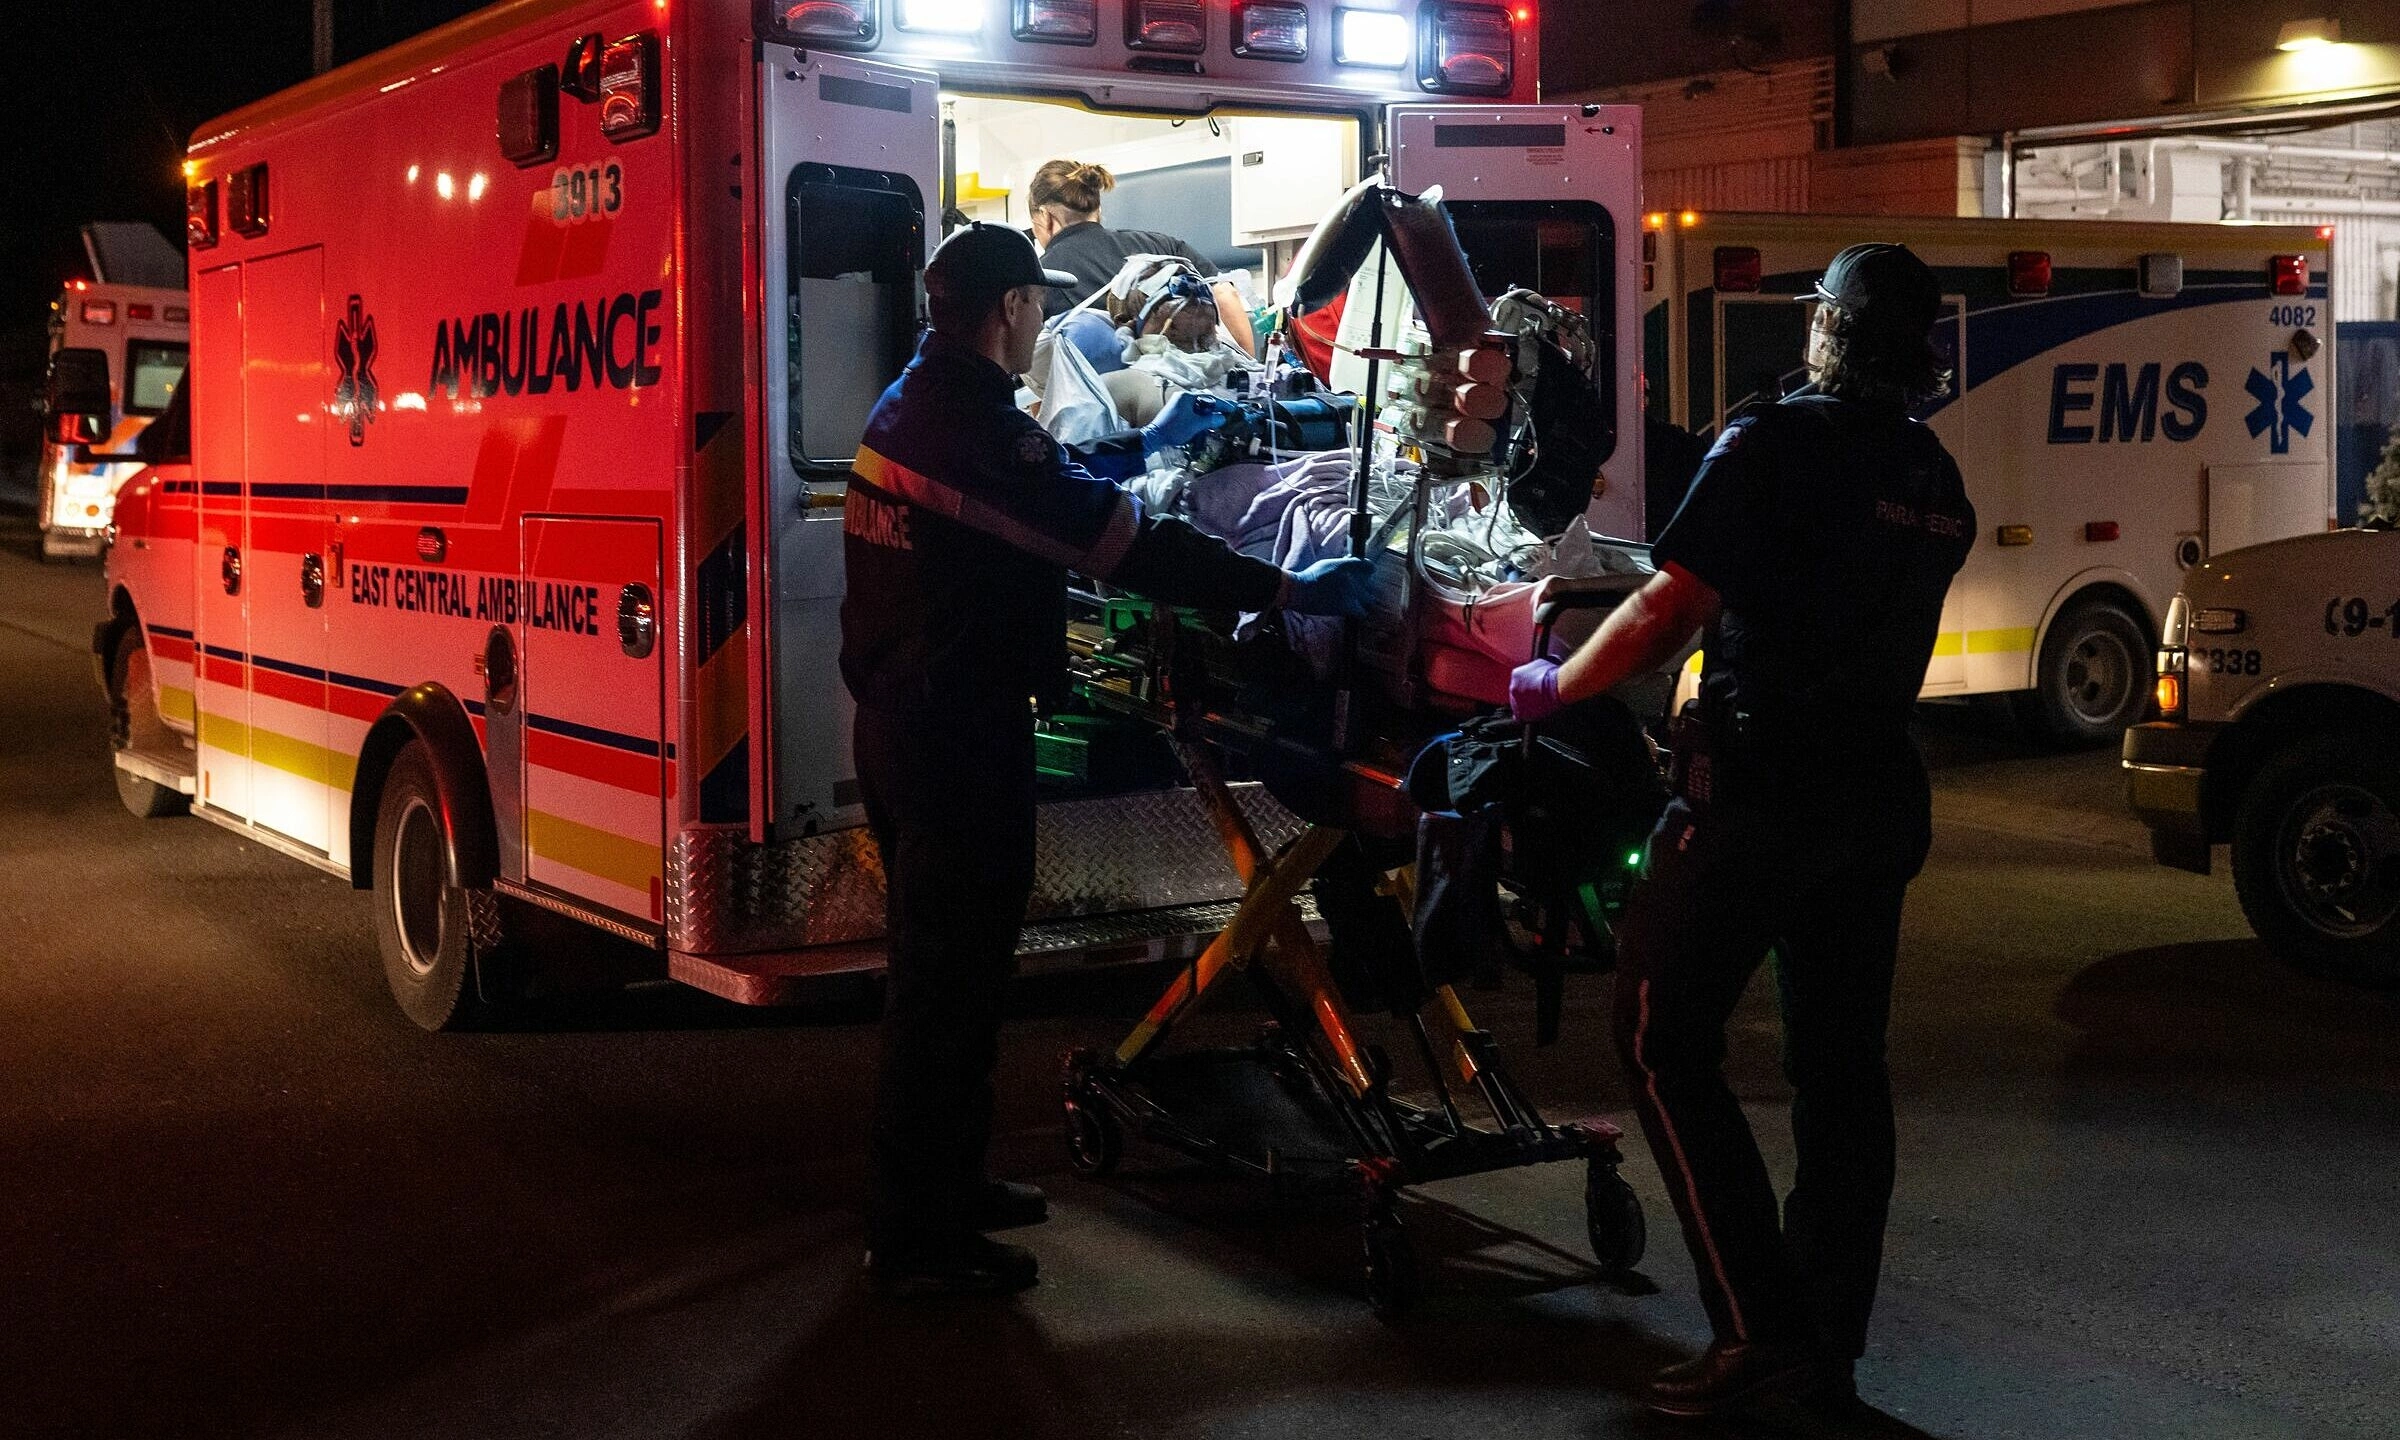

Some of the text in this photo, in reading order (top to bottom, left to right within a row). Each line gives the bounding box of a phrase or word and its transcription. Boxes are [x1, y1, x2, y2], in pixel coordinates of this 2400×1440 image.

[428, 290, 662, 399] AMBULANCE
[2269, 305, 2316, 327] 4082
[2047, 361, 2209, 443] EMS
[1874, 499, 1963, 538] PARAEDIC
[351, 564, 599, 636] EAST CENTRAL AMBULANCE
